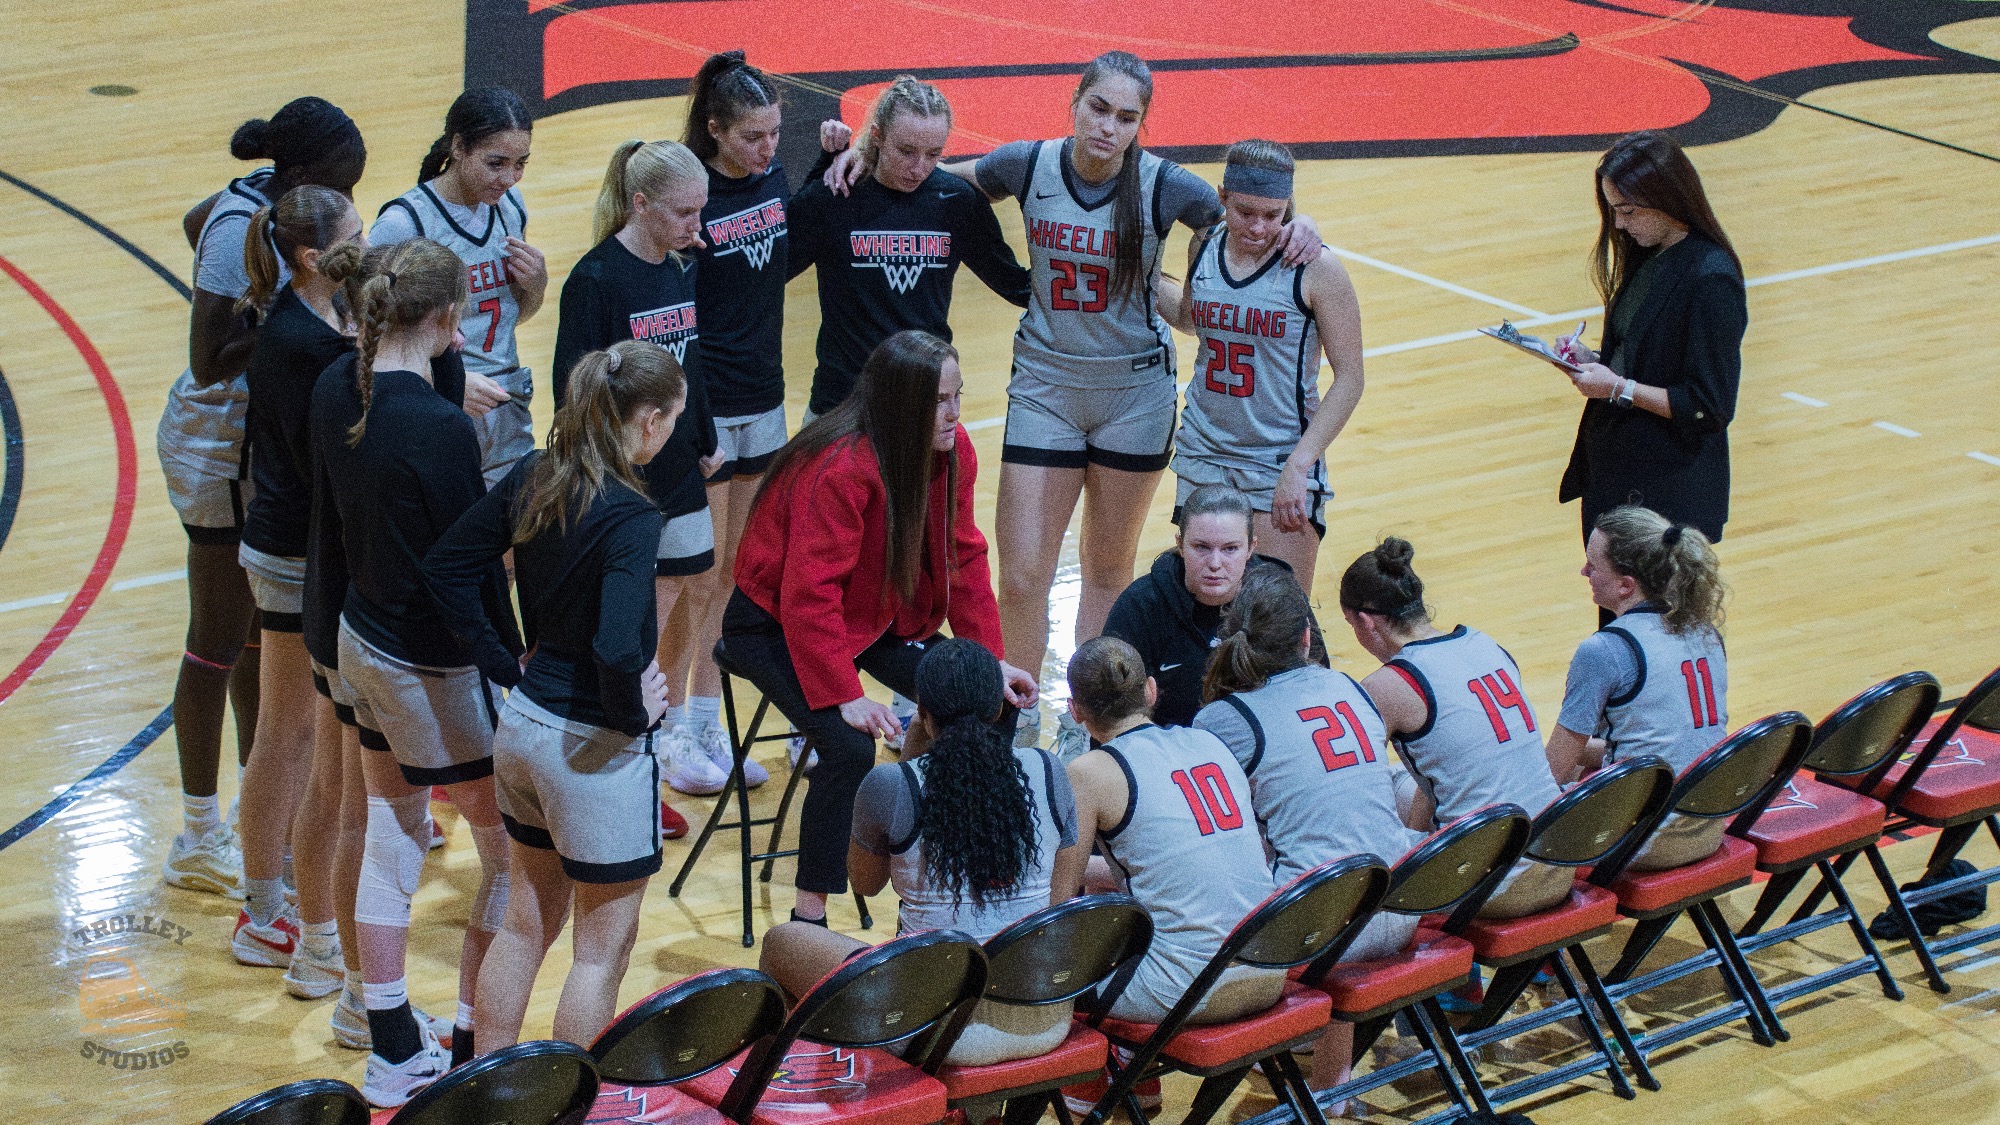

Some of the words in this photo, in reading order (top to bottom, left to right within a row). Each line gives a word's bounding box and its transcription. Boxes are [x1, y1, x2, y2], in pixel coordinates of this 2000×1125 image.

[707, 202, 786, 246] WHEELING
[850, 235, 951, 258] WHEELING
[1029, 217, 1117, 258] WHEELI
[1050, 258, 1109, 312] 23
[478, 296, 502, 352] 7
[1205, 337, 1254, 397] 25
[1467, 668, 1536, 744] 14
[1681, 657, 1719, 730] 11
[1296, 700, 1377, 773] 21
[1170, 762, 1243, 836] 10
